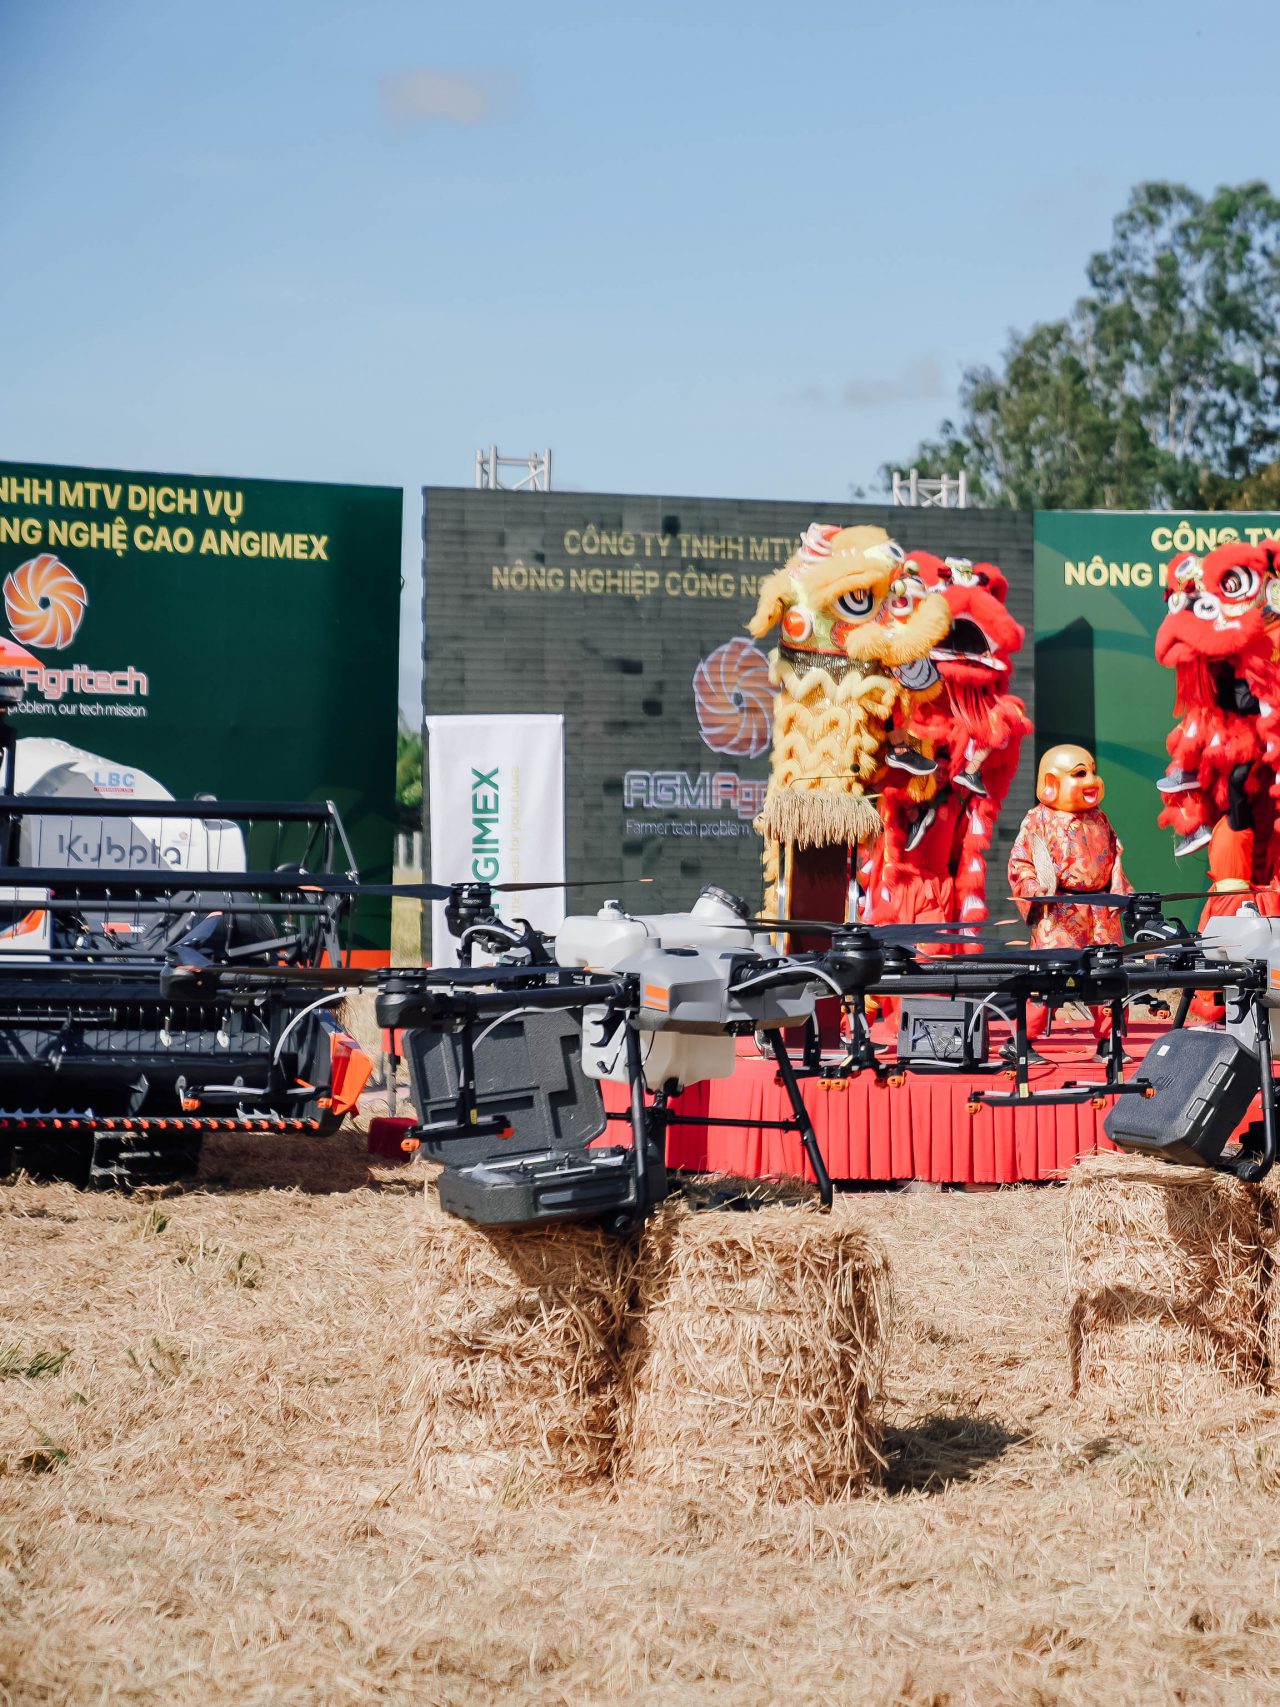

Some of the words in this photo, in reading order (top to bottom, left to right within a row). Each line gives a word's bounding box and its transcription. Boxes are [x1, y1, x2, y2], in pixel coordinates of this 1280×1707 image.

[59, 480, 122, 510] MTV
[128, 484, 198, 519] DỊCH
[203, 488, 243, 524] VỤ
[0, 516, 43, 545] NG
[48, 515, 128, 557] NGHỆ
[133, 524, 195, 554] CAO
[200, 528, 329, 561] ANGIMEX
[563, 522, 636, 557] CÔNG
[641, 532, 671, 557] TY
[676, 533, 744, 561] TNHH
[491, 558, 565, 592] NÔNG
[569, 562, 660, 602] NGHIỆP
[665, 564, 735, 598] CÔNG
[1064, 555, 1153, 588] NÔNG
[80, 702, 104, 716] tech
[105, 702, 147, 717] mission
[95, 772, 135, 788] LBC
[471, 767, 500, 919] GIMEX
[626, 819, 669, 836] Farmer
[672, 820, 698, 837] tech
[58, 834, 181, 866] Kubota
